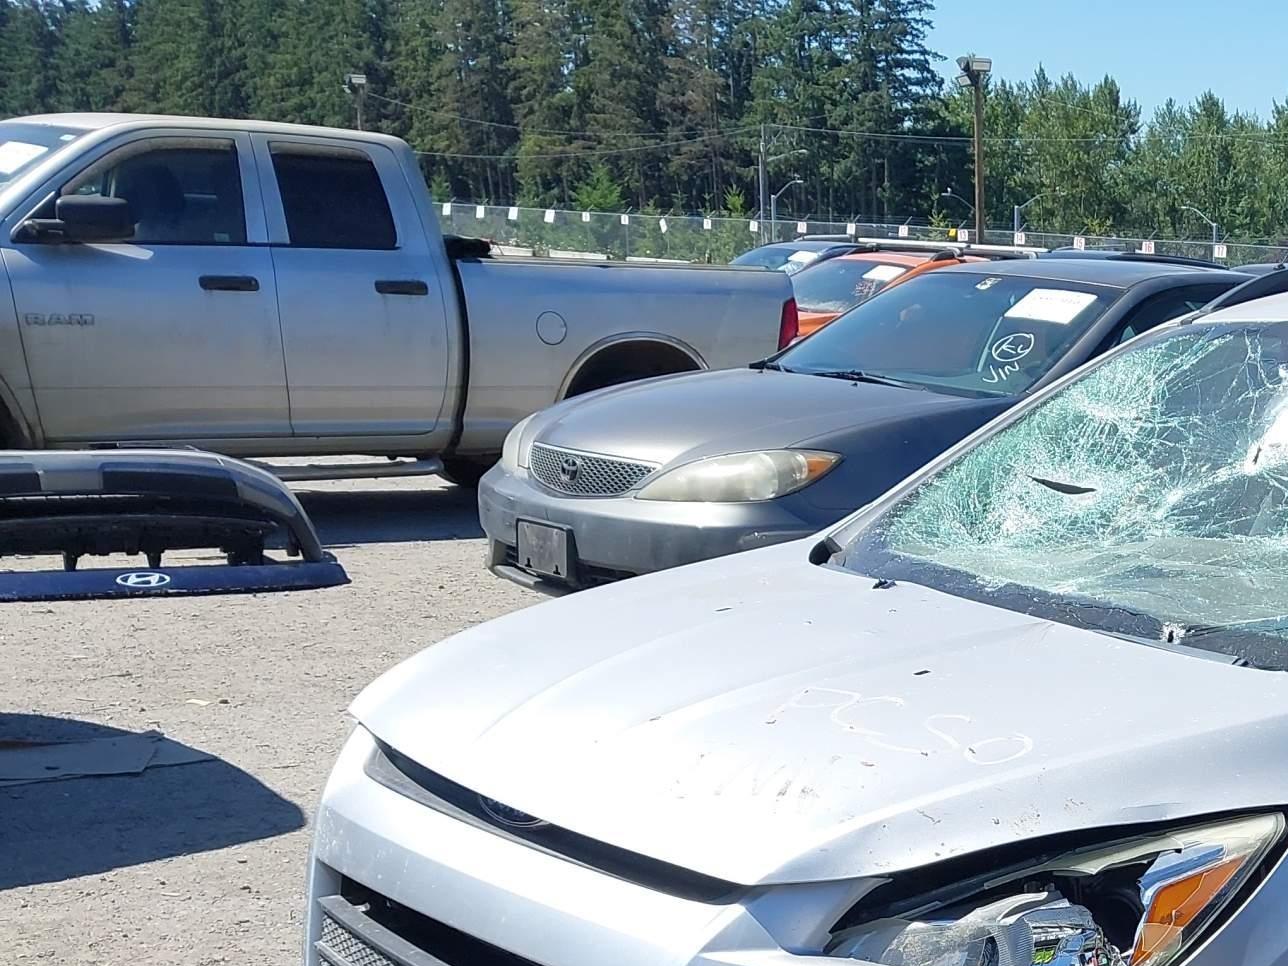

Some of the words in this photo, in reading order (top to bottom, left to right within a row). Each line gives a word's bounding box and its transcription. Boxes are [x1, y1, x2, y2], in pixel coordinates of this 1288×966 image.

[1075, 238, 1083, 247] 15
[1144, 242, 1153, 252] 16
[1216, 246, 1225, 256] 17
[24, 312, 96, 327] RAM
